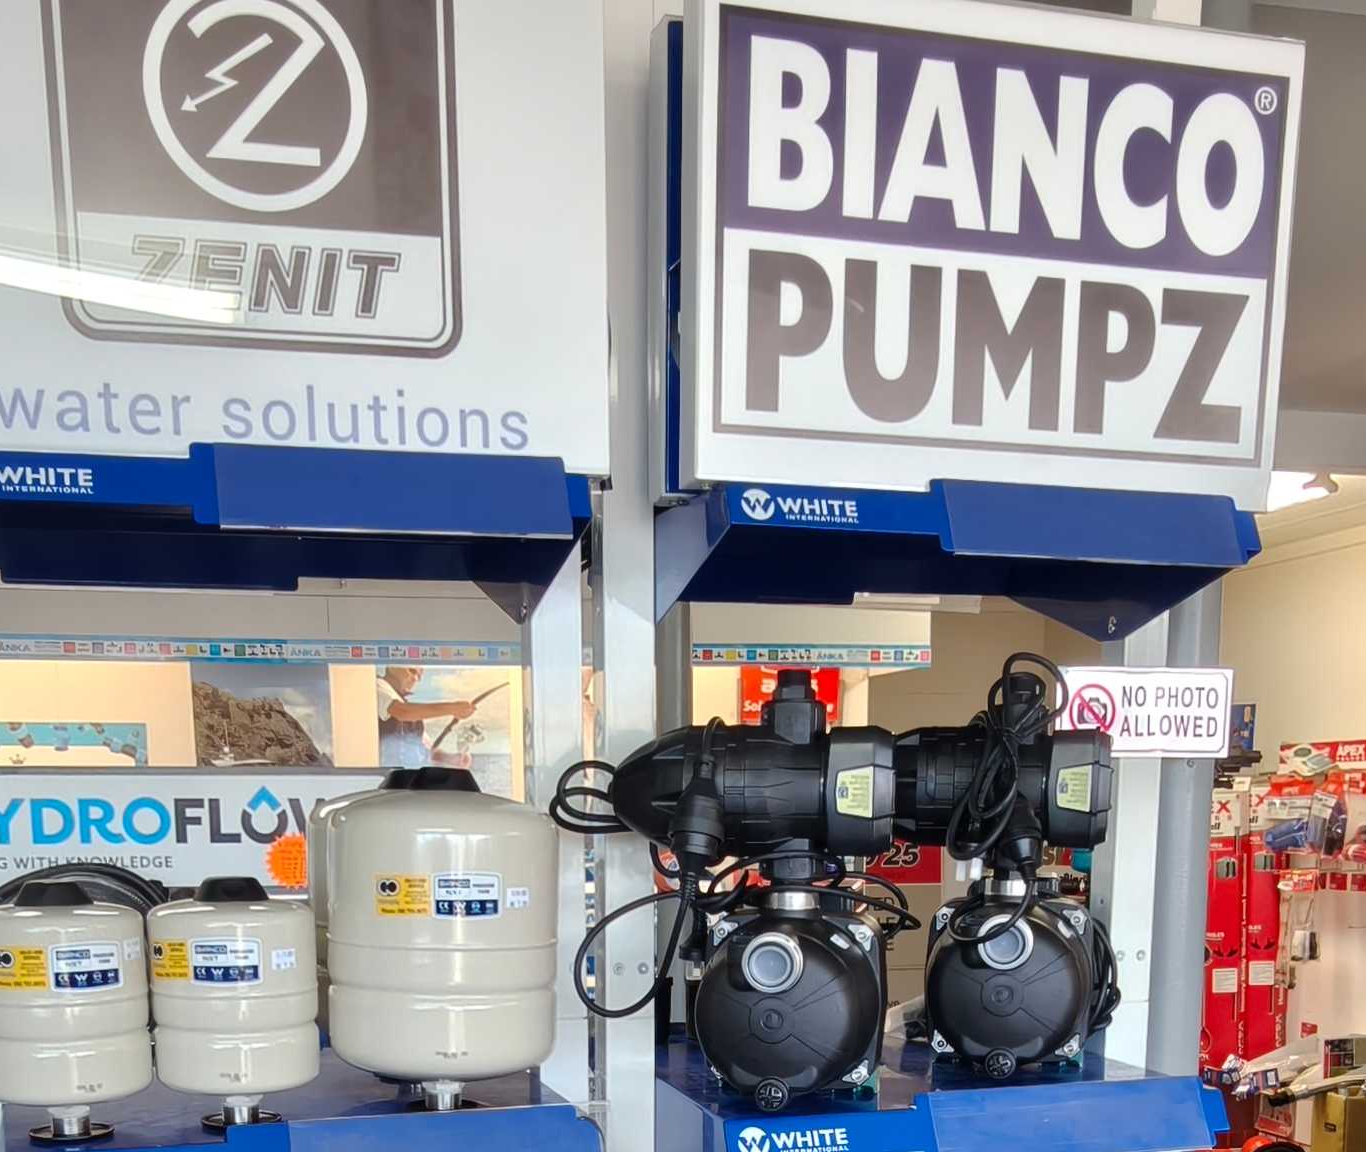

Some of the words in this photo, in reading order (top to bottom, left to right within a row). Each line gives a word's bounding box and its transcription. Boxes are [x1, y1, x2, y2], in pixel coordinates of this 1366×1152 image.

[748, 34, 1264, 256] BIANCO
[131, 234, 401, 319] ZENIT
[745, 249, 1250, 444] PUMPZ
[222, 385, 529, 450] solutions
[2, 482, 93, 494] INTERNATIONAL
[778, 496, 858, 519] WHITE
[786, 513, 858, 524] INTERNATIONAL
[1121, 686, 1147, 708] NO
[1155, 686, 1219, 709] PHOTO
[1120, 716, 1218, 738] ALLOWED
[13, 856, 57, 869] WITH
[771, 1128, 847, 1150] WHITE
